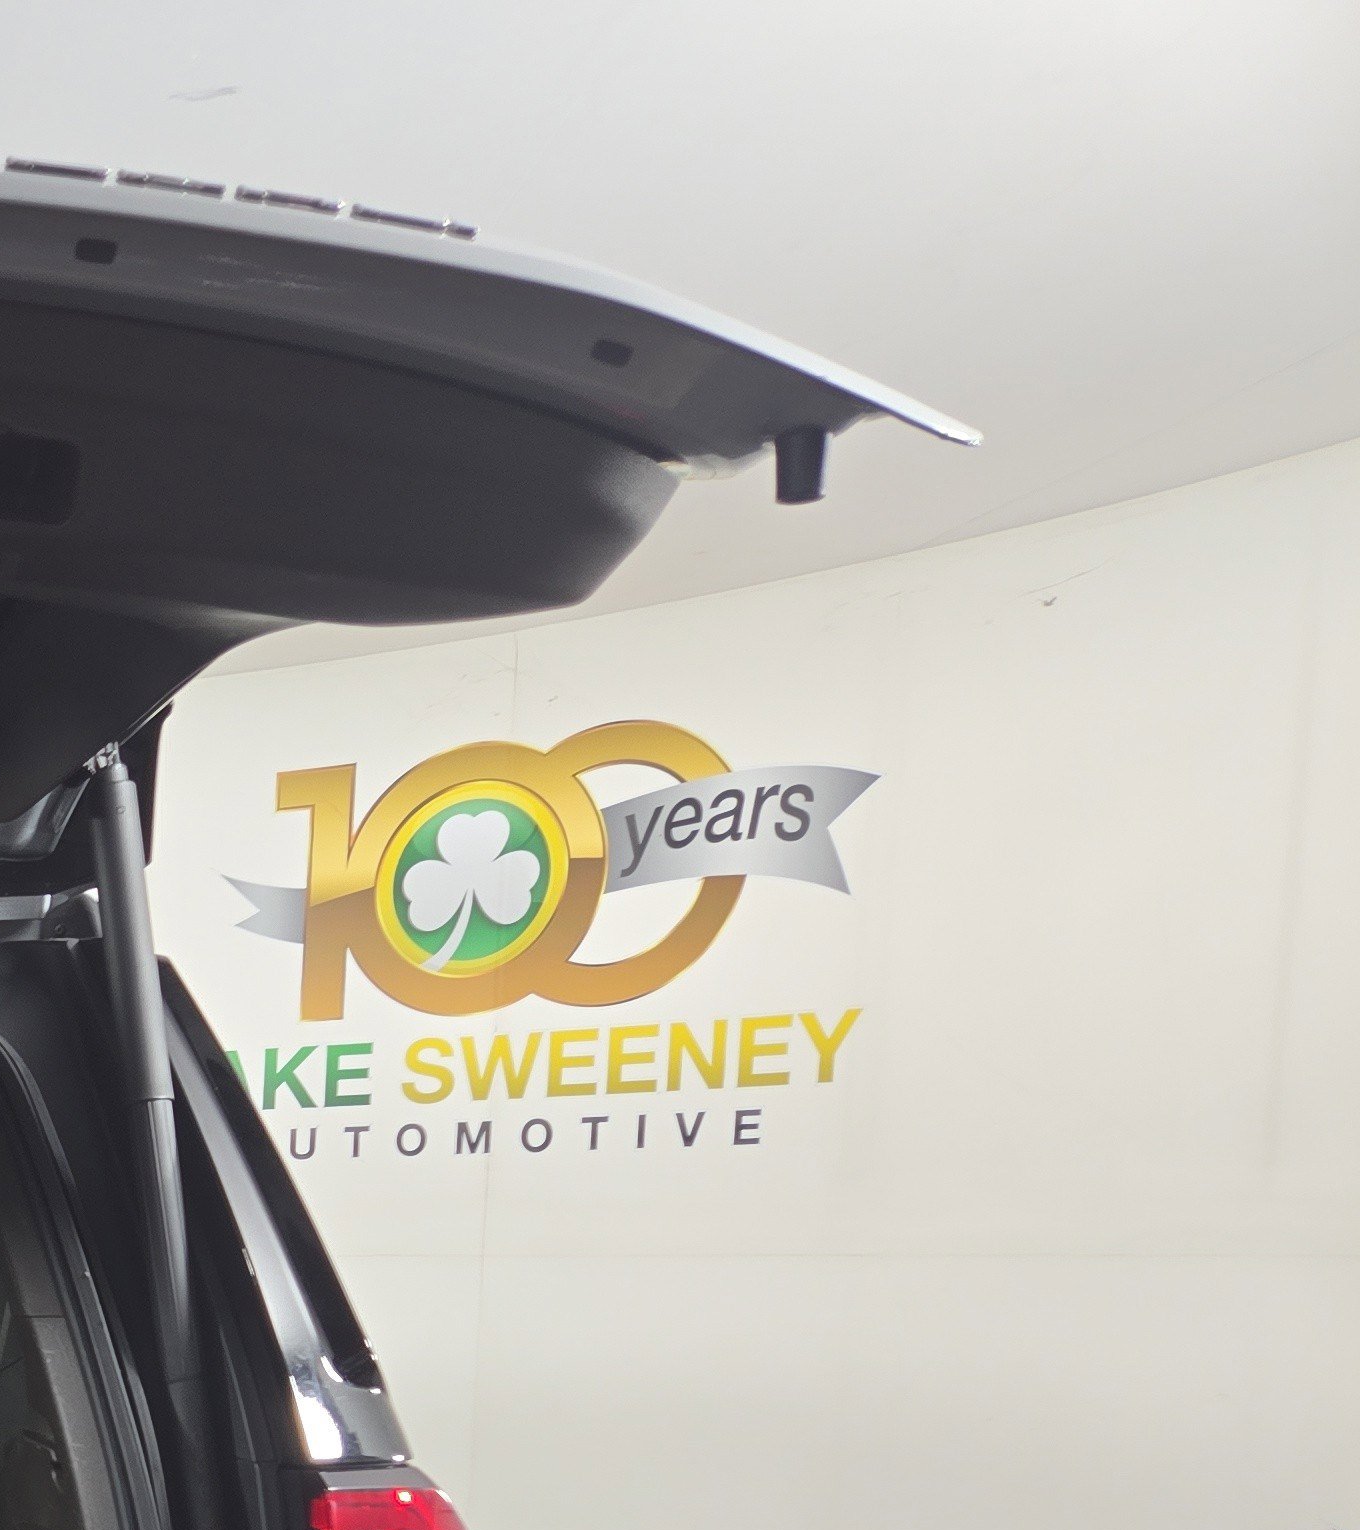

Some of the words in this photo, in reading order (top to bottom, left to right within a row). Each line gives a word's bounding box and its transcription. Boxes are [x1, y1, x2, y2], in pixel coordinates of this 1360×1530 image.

[620, 779, 815, 878] years
[225, 1042, 374, 1110] KE
[401, 1008, 864, 1105] SWEENEY
[289, 1108, 764, 1160] UTOMOTIVE
